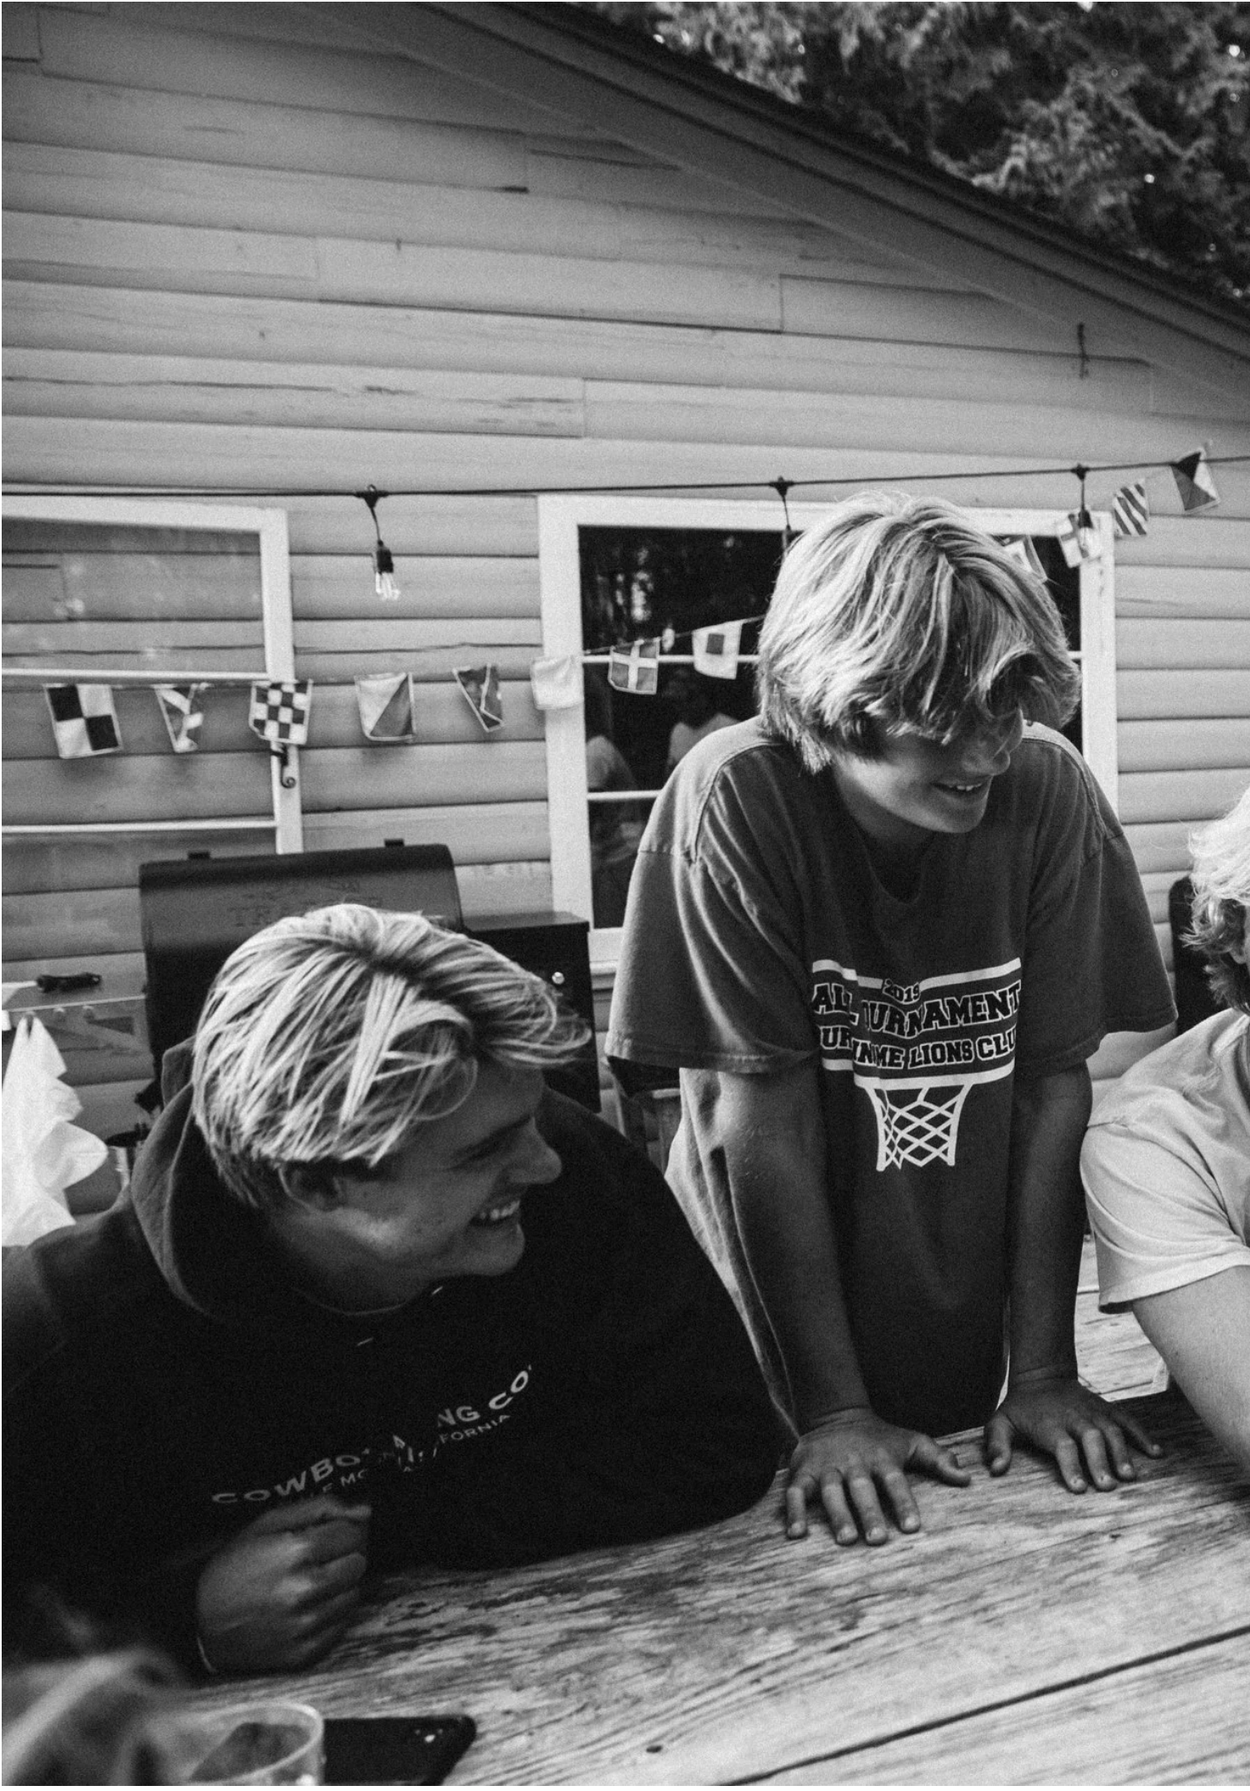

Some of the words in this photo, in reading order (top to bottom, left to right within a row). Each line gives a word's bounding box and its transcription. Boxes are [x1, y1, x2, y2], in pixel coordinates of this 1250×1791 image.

[882, 978, 920, 1005] 2019
[907, 1039, 975, 1070] LIONS
[975, 1024, 1017, 1061] CLU
[212, 1448, 370, 1503] COWBO
